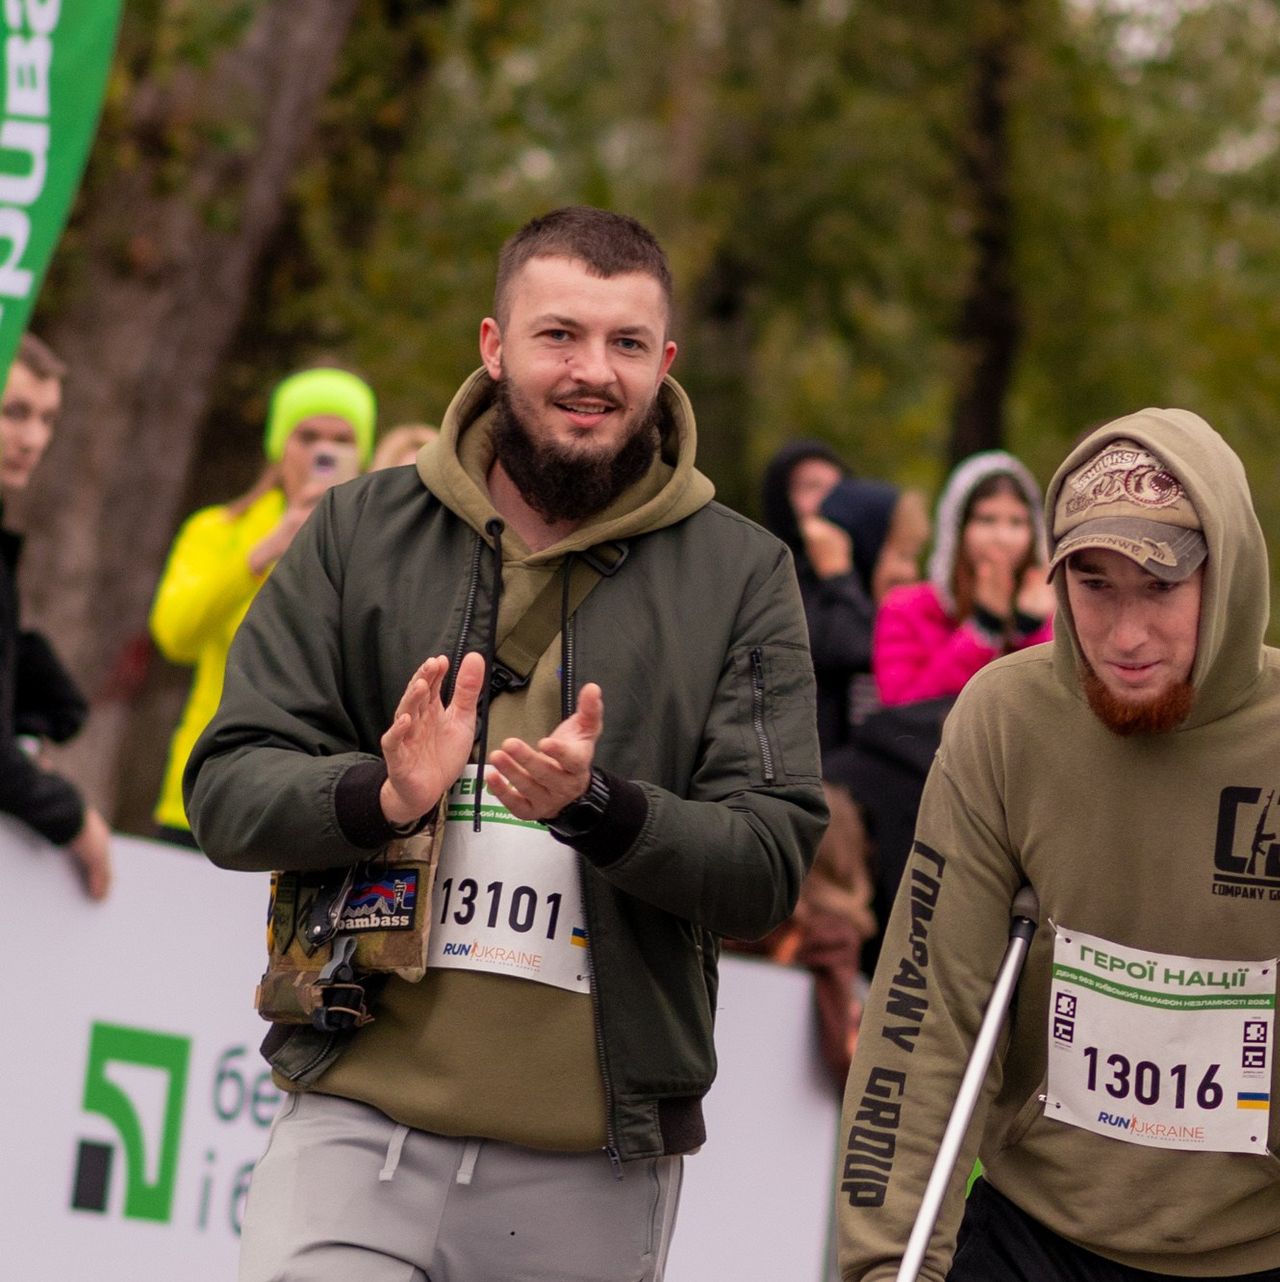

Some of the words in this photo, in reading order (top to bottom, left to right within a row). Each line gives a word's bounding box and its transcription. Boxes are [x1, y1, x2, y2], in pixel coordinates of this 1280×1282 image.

[440, 877, 562, 940] 13101
[1211, 883, 1265, 900] COMPANY
[443, 943, 472, 956] RUN
[1080, 945, 1158, 981] ГЕРОЇ
[1163, 968, 1250, 989] НАЦІЇ
[1083, 1046, 1223, 1110] 13016
[841, 1066, 907, 1207] GROUP
[1097, 1111, 1131, 1129] RUN
